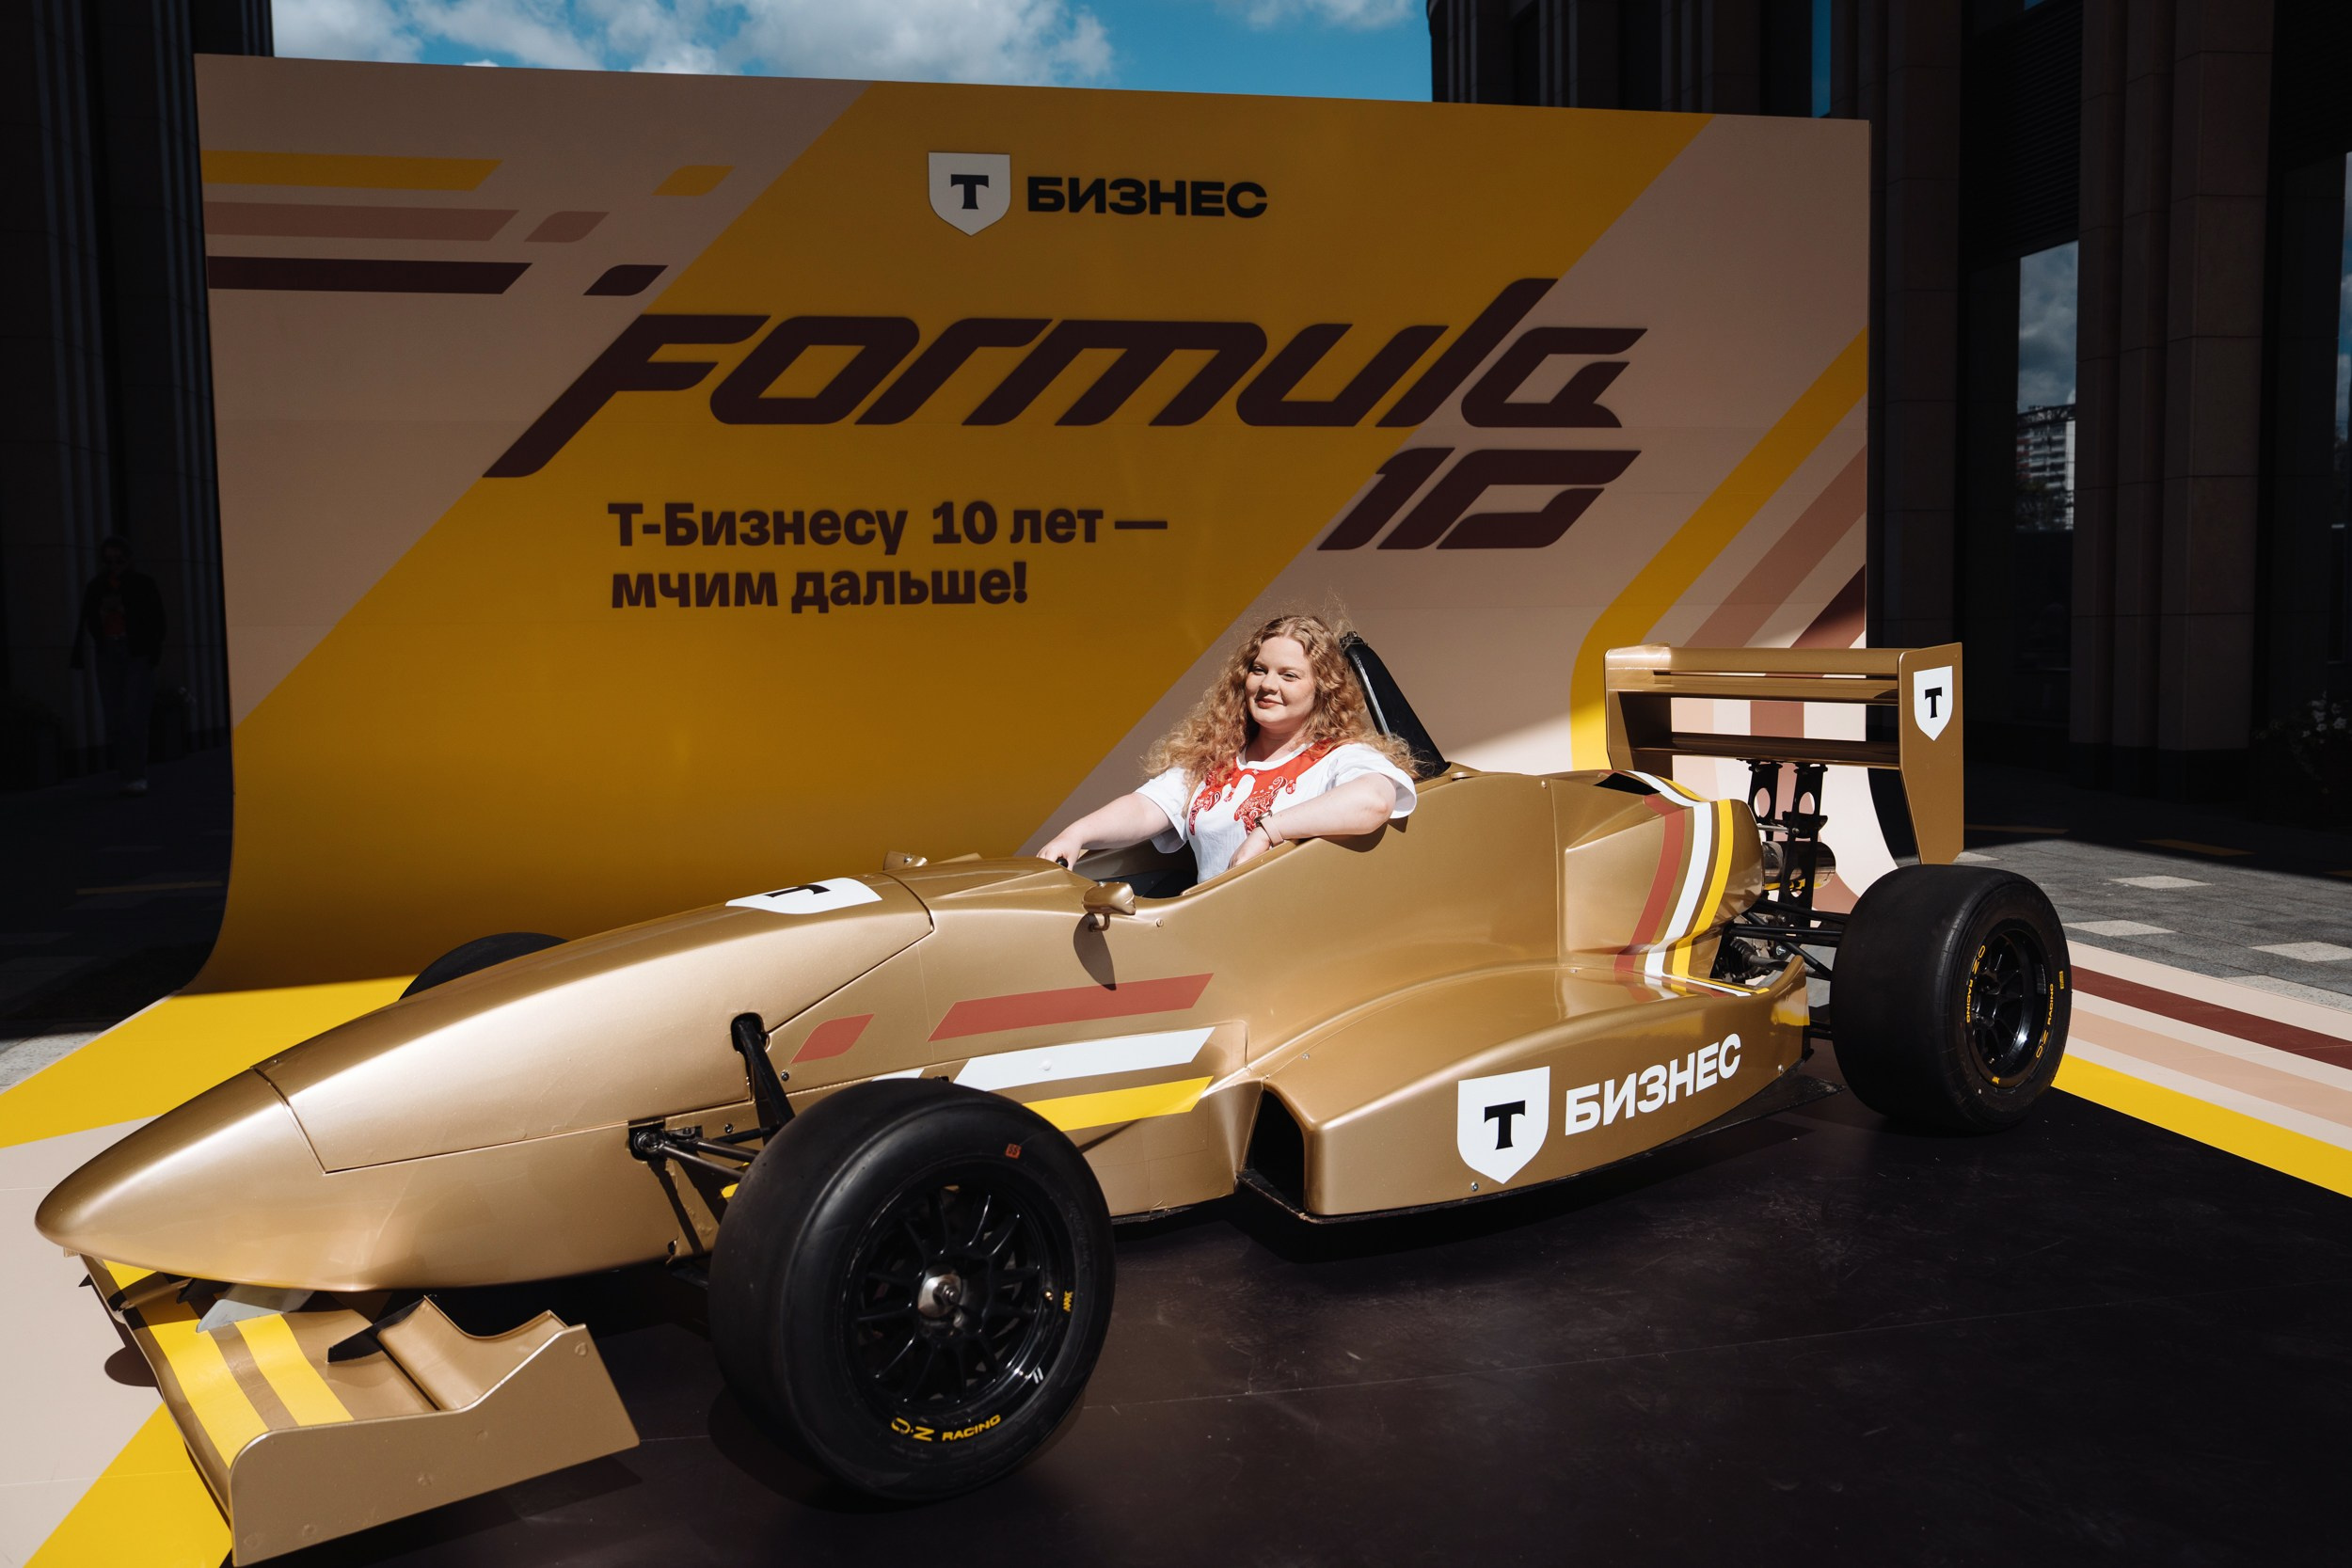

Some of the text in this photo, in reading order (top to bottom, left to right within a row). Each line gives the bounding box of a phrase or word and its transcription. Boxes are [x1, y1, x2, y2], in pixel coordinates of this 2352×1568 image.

[1026, 176, 1268, 219] БИЗНЕС
[481, 277, 1649, 478] Formula
[1316, 447, 1643, 551] 10
[607, 502, 909, 555] Т-Бизнесу
[931, 500, 998, 545] 10
[1009, 508, 1104, 544] лет
[612, 561, 1028, 614] мчим дальше!
[1965, 979, 1974, 1023] RACING
[1565, 1033, 1741, 1136] БИЗНЕС
[942, 1414, 1001, 1441] RACING
